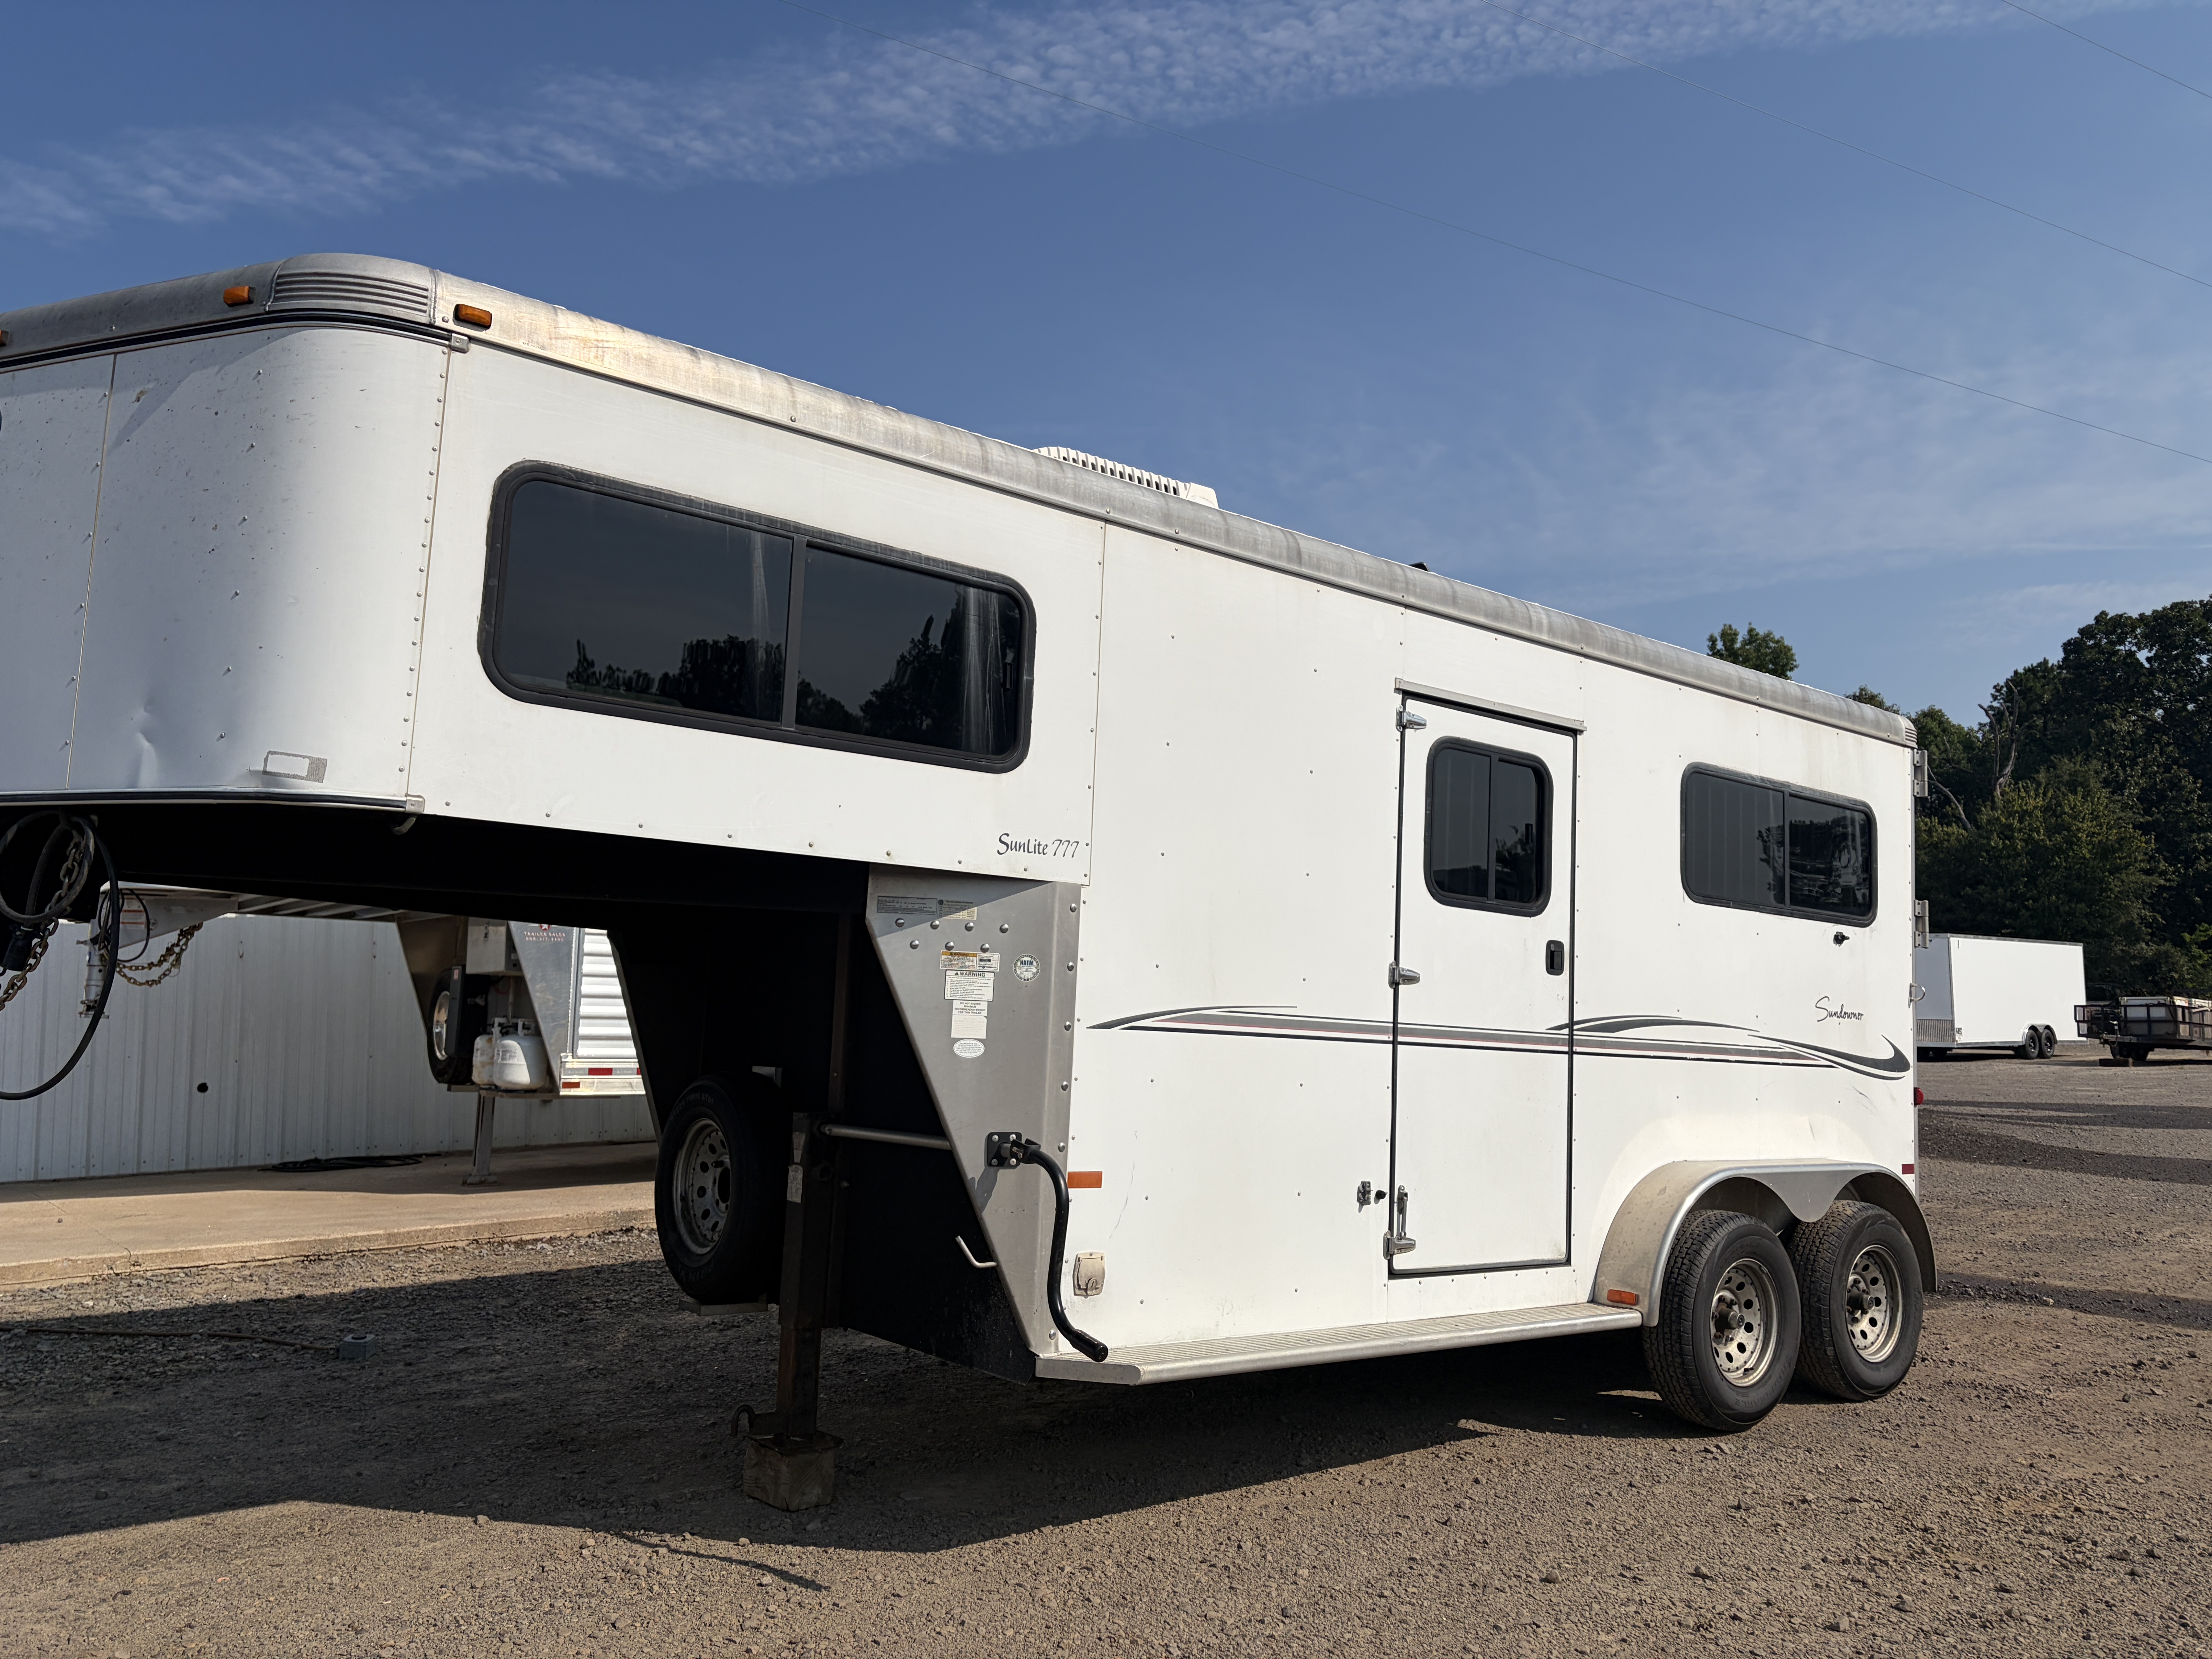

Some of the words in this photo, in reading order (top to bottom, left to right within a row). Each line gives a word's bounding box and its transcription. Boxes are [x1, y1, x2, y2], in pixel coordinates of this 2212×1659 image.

[997, 833, 1048, 855] SunLite
[1052, 839, 1079, 858] 777
[1815, 996, 1863, 1022] Sundowner
